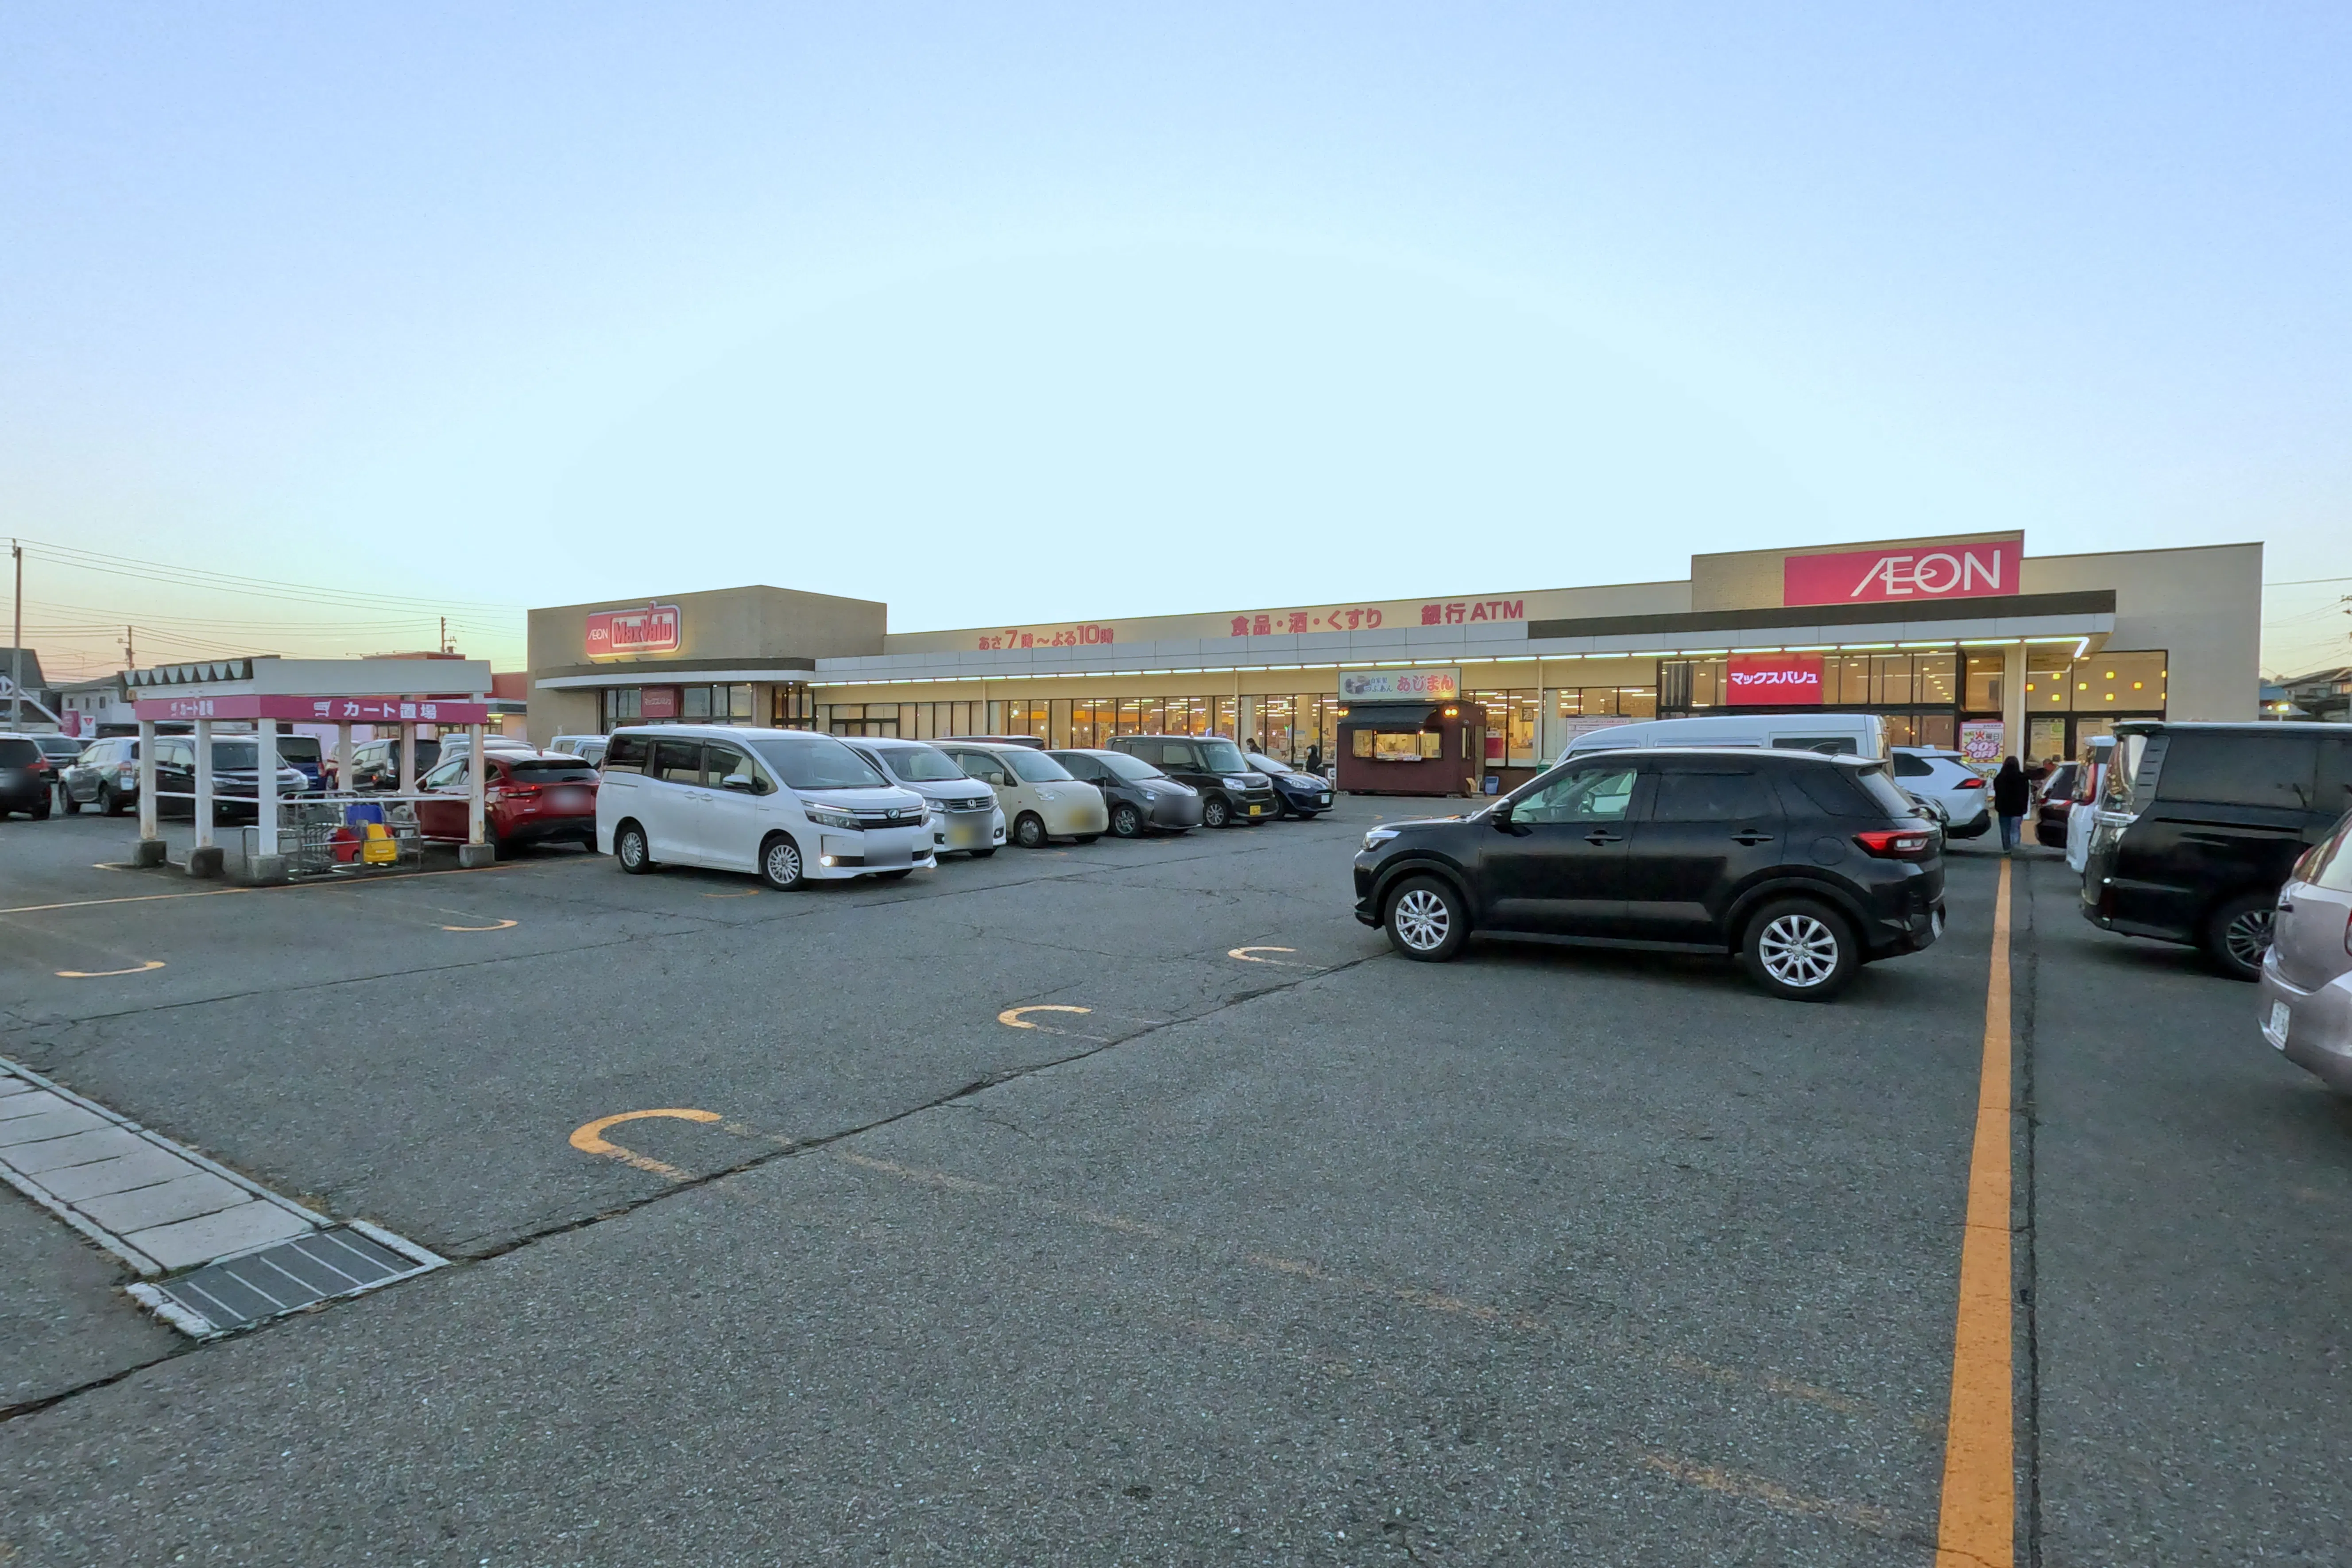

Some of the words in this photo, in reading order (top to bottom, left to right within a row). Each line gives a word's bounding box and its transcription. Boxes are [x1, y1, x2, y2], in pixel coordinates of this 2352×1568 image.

[1231, 608, 1382, 636] 食品・酒・くすり
[1396, 674, 1455, 693] あじまん
[1730, 670, 1818, 685] マックスバリュ
[343, 701, 437, 720] カート置場
